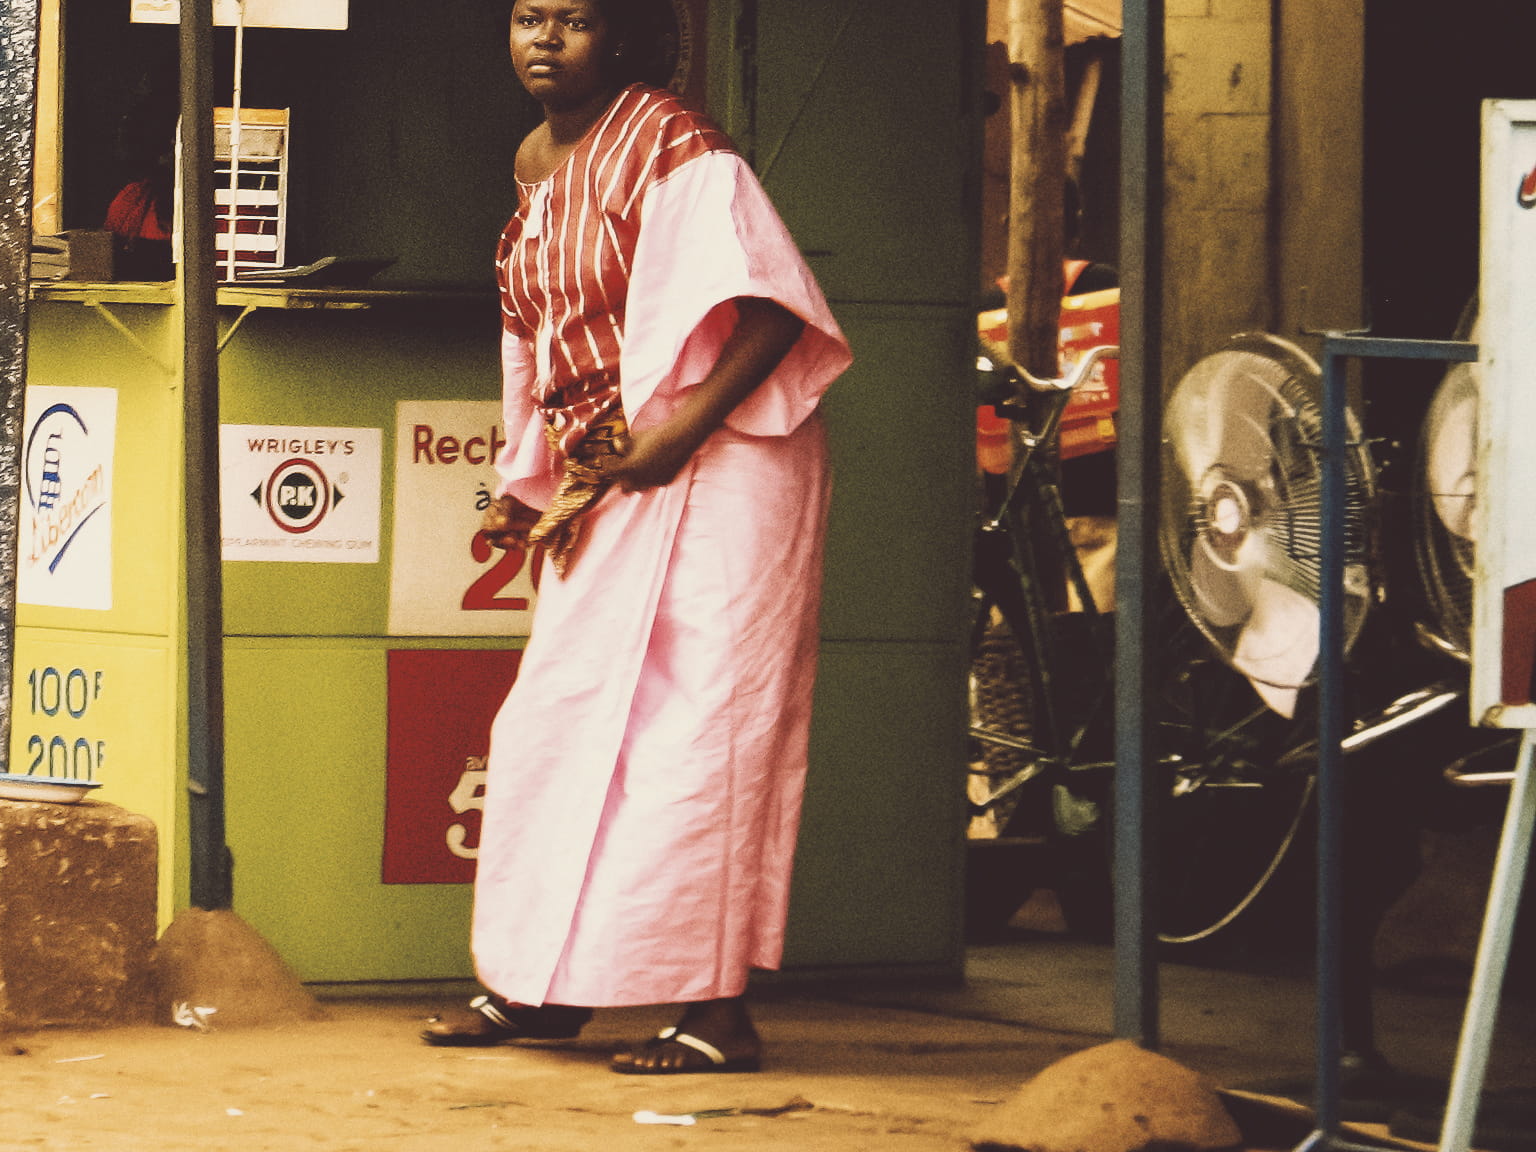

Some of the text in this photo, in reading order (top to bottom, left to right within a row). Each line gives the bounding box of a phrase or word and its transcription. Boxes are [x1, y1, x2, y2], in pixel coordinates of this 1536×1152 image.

[248, 438, 356, 455] WRIGLEY'S
[413, 424, 506, 465] Rech
[461, 529, 546, 611] 2
